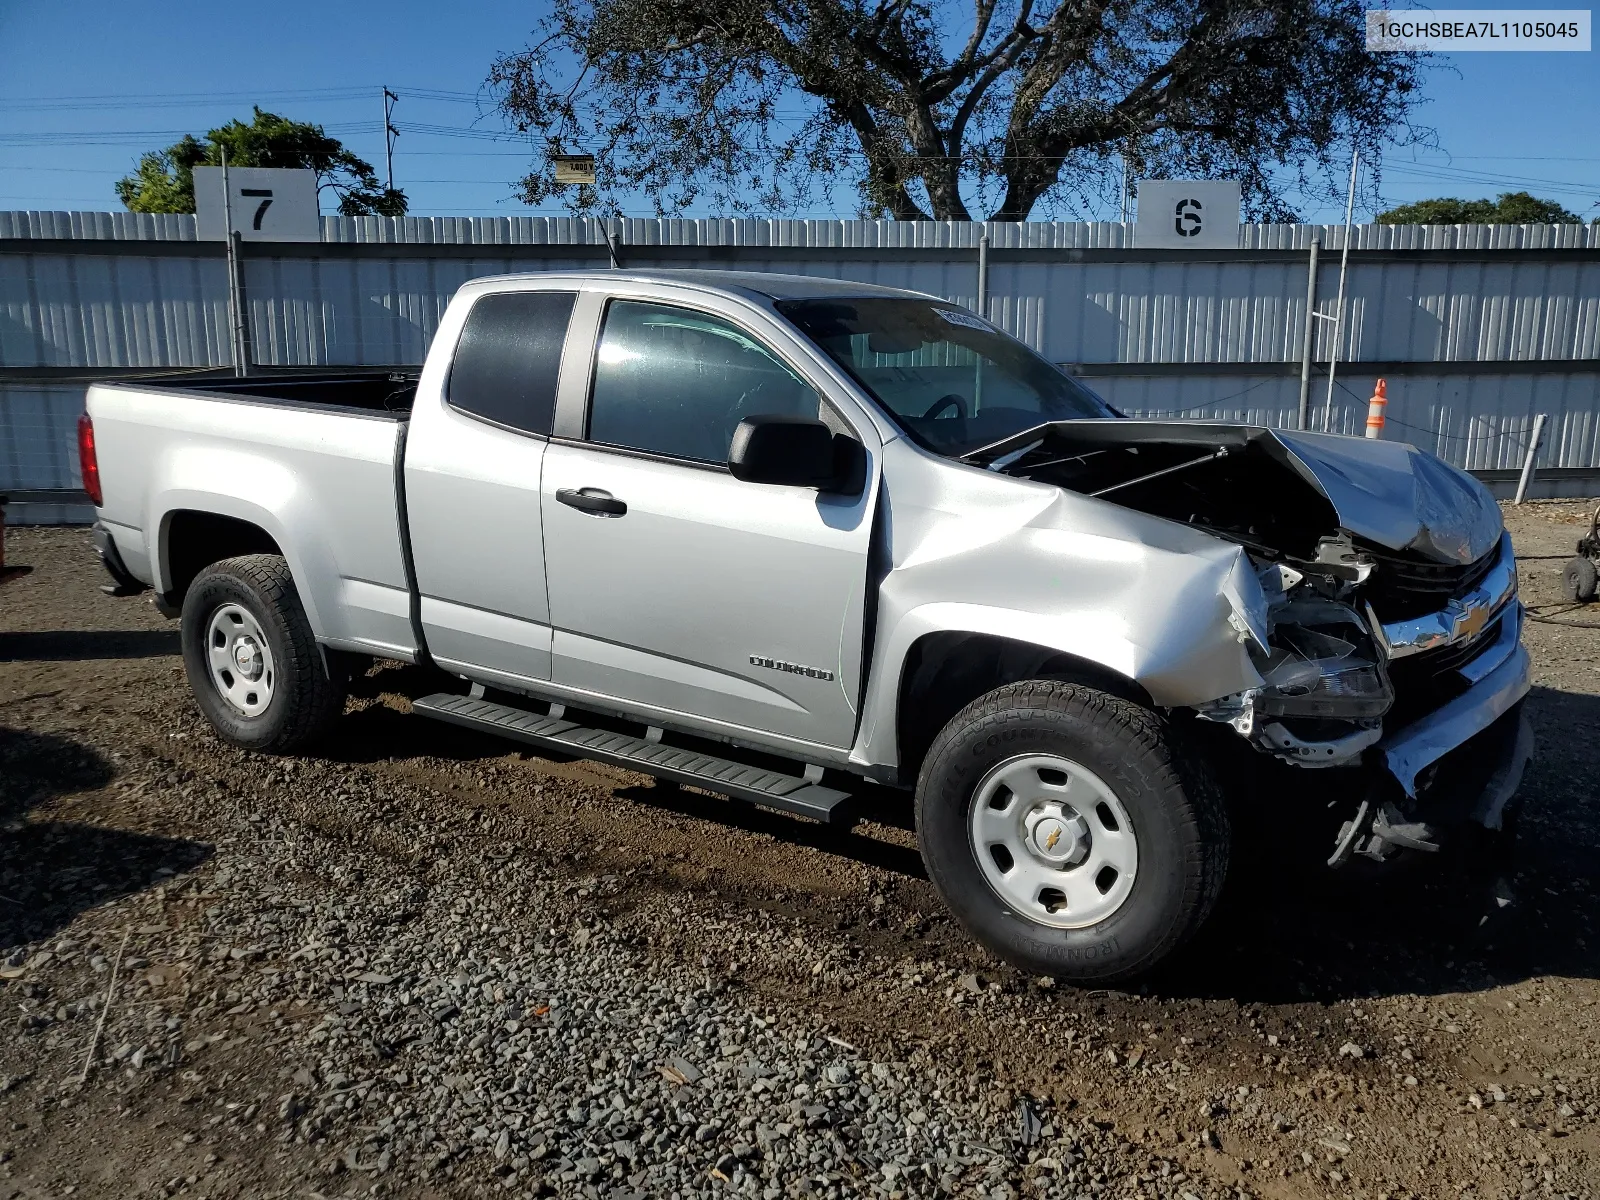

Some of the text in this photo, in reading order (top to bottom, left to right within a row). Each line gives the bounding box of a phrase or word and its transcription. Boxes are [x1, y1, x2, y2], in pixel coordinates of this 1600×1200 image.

[241, 188, 274, 231] 7
[1175, 198, 1203, 238] 6
[749, 654, 834, 681] COLORADO
[1009, 931, 1121, 962] IRONMAN
